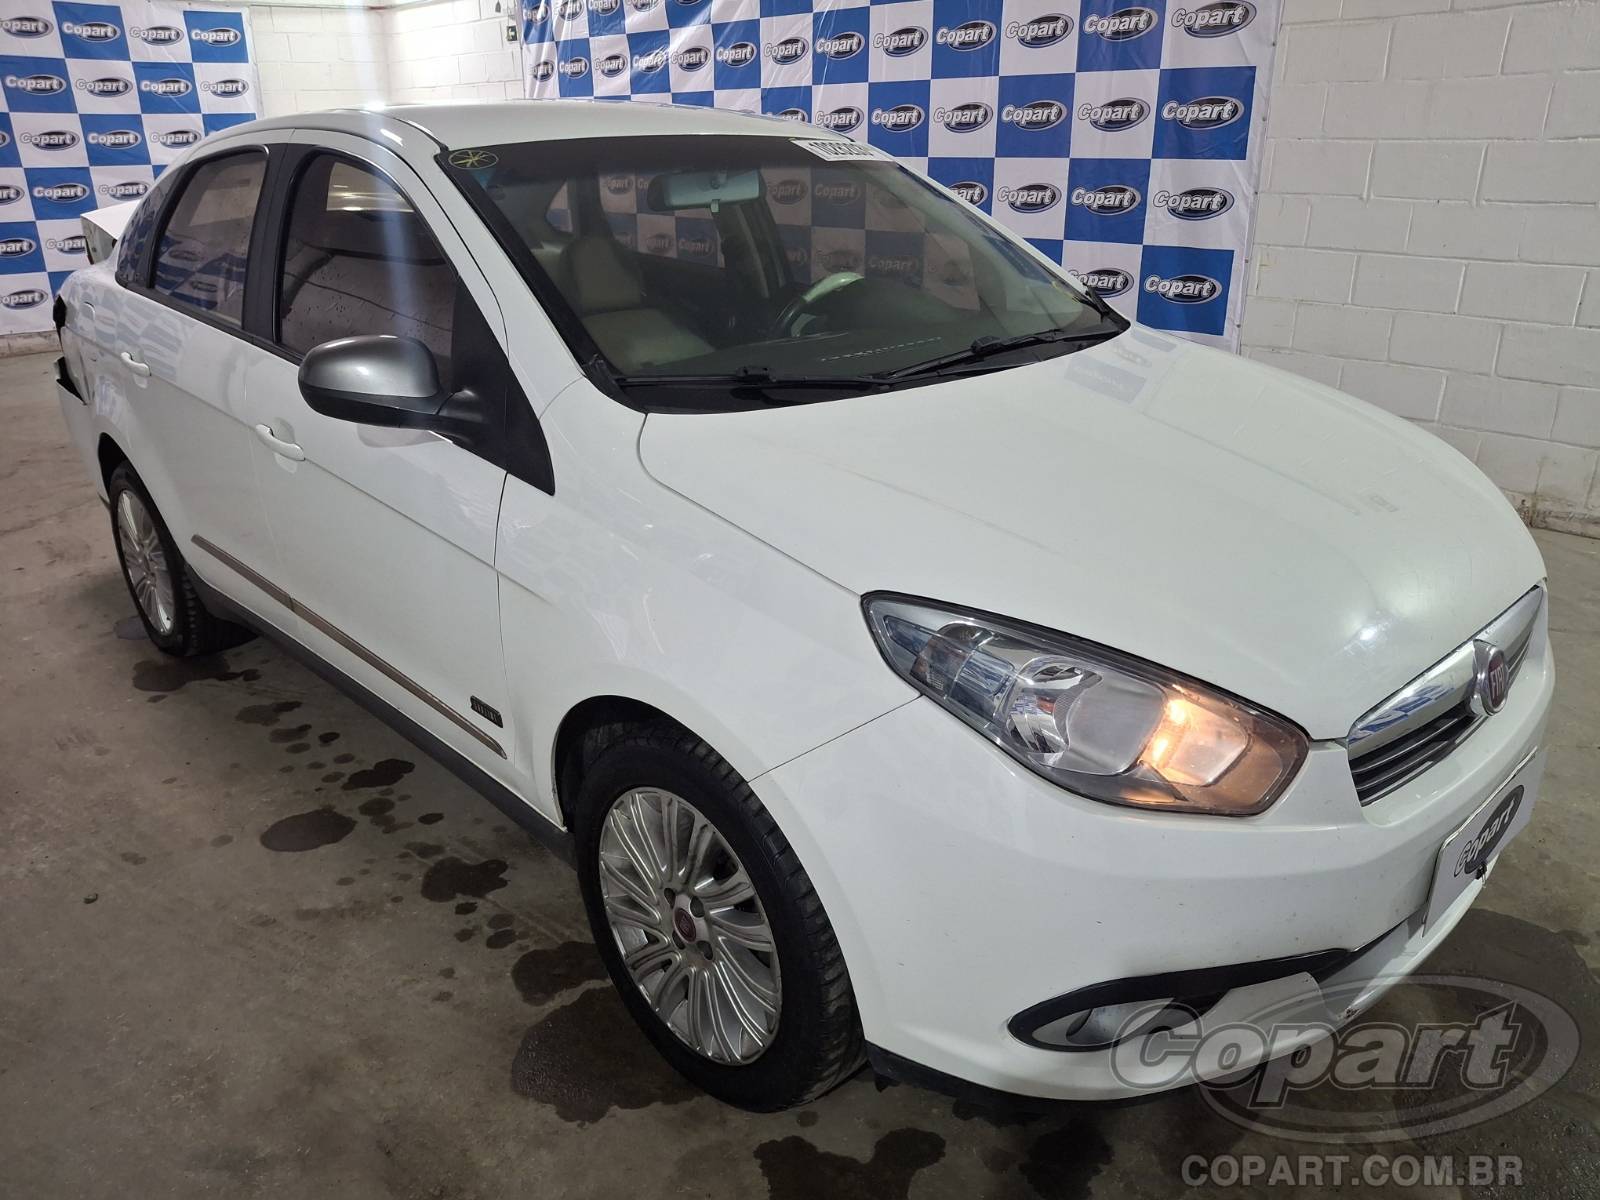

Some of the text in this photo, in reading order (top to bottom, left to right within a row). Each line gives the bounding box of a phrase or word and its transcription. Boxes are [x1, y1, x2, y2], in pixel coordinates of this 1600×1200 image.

[1083, 11, 1148, 36] Copart
[1171, 5, 1246, 29] Copart
[0, 20, 45, 33] opart
[62, 22, 115, 39] Copart
[130, 27, 178, 42] Copart
[936, 24, 989, 45] Copart
[1005, 19, 1064, 42] Copart
[191, 29, 235, 43] Copart
[816, 36, 859, 53] Copart
[873, 31, 919, 49] Copart
[671, 50, 707, 68] Copart
[716, 44, 752, 64] Copart
[764, 41, 803, 60] Copart
[560, 60, 586, 75] Copart
[595, 57, 624, 74] Copart
[5, 76, 60, 91] Copart
[76, 78, 126, 93] Copart
[141, 80, 186, 94] Copart
[200, 80, 244, 94] Copart
[815, 110, 857, 128] Copart
[872, 108, 917, 126] Copart
[934, 107, 984, 126] Copart
[1002, 103, 1059, 123] Copart
[1078, 102, 1141, 122] Copart
[1162, 100, 1233, 121] Copart
[20, 132, 73, 147] Copart
[88, 131, 134, 145] Copart
[151, 131, 195, 145] Copart
[33, 186, 84, 201] Copart
[99, 184, 146, 199] Copart
[998, 186, 1053, 206] Copart
[1072, 188, 1131, 207] Copart
[1154, 191, 1223, 211] Copart
[1145, 275, 1211, 297] Copart
[1, 291, 41, 306] opart
[1454, 797, 1515, 877] Copart
